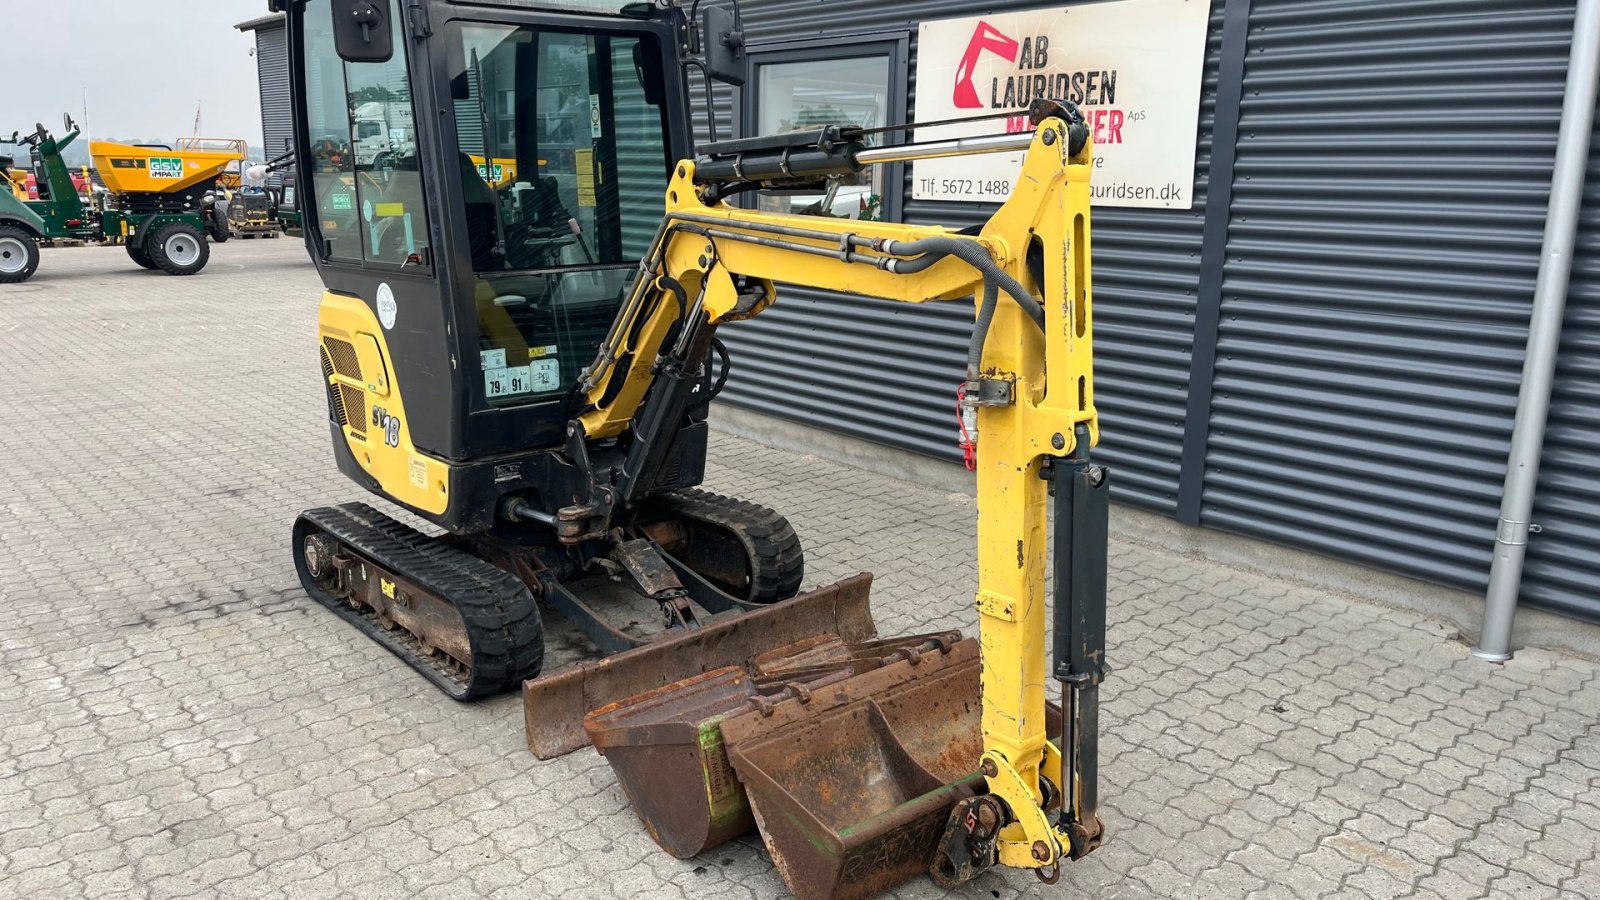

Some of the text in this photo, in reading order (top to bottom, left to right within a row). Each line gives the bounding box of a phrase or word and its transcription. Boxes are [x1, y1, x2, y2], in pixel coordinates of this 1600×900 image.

[1018, 35, 1049, 70] AB
[991, 70, 1117, 109] LAURIDSEN
[1127, 109, 1146, 121] ApS
[151, 161, 181, 171] GSV
[920, 178, 1010, 197] Tlf. 5672 1488
[490, 380, 501, 394] 79
[511, 377, 522, 392] 91
